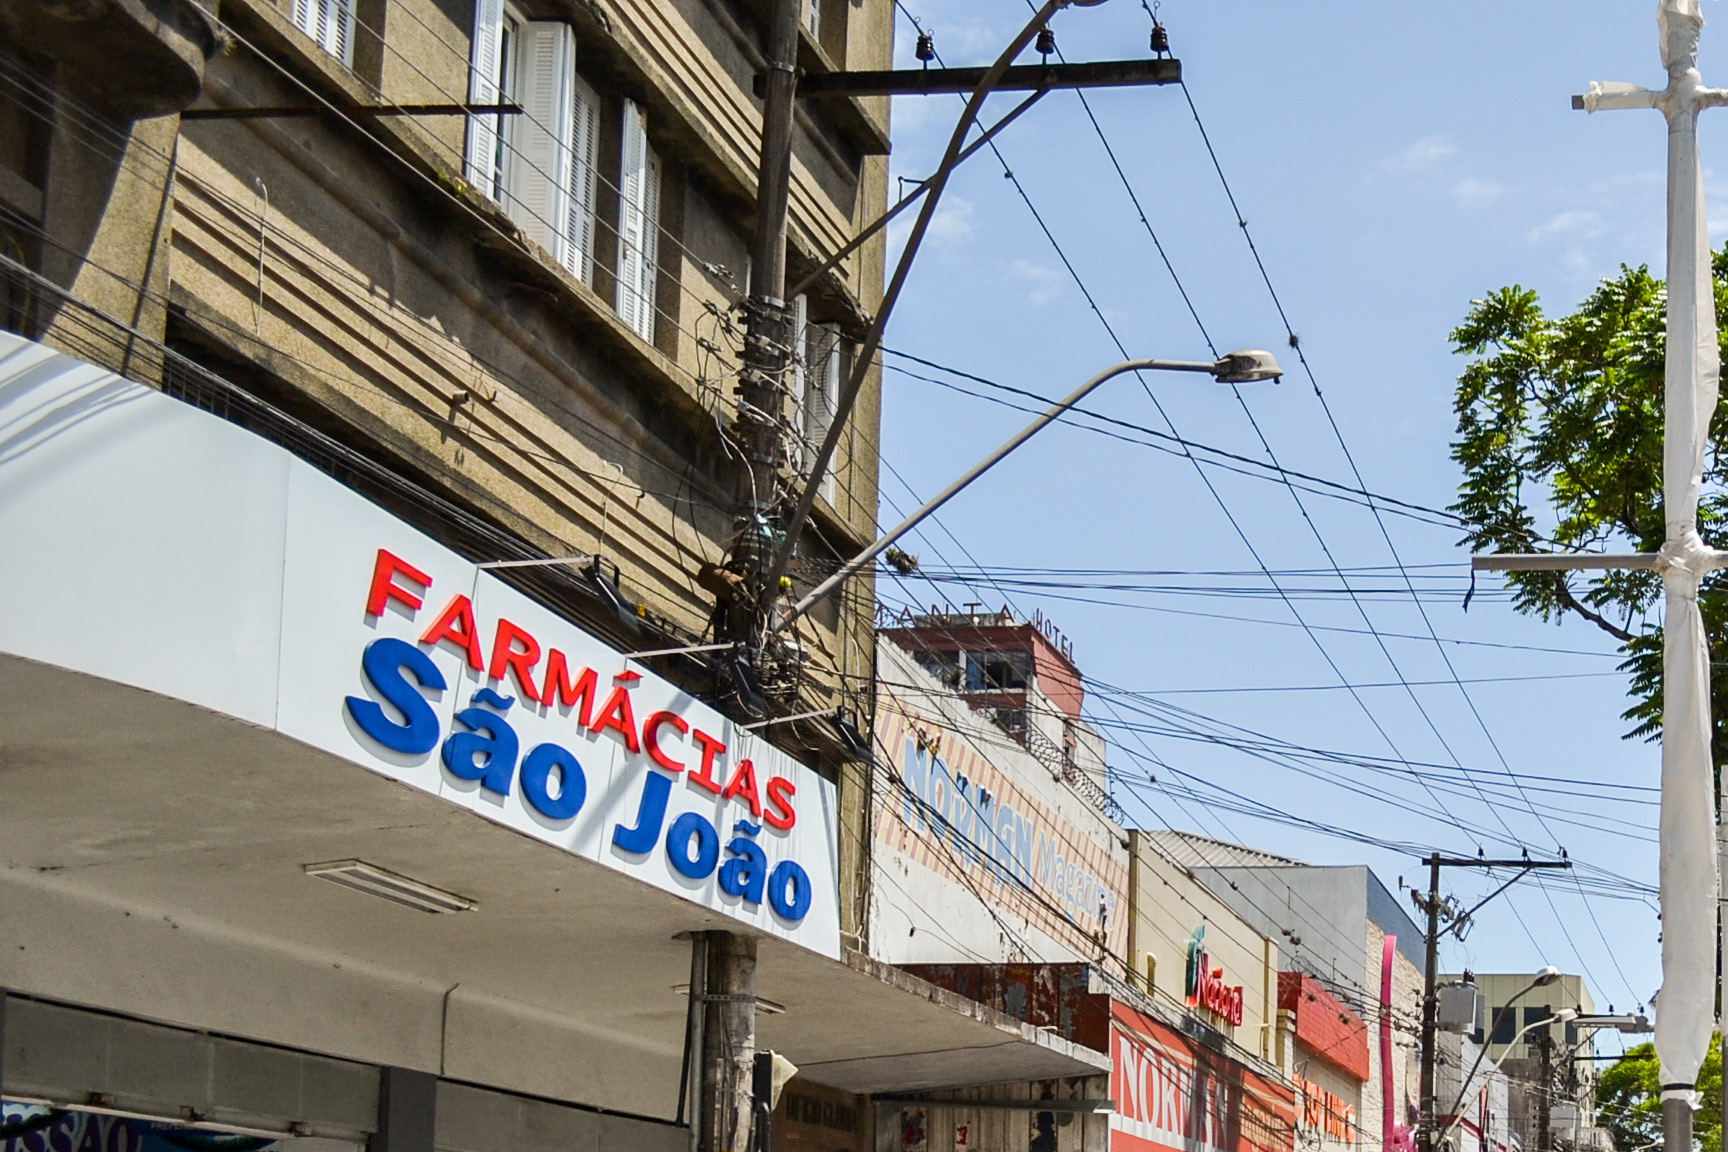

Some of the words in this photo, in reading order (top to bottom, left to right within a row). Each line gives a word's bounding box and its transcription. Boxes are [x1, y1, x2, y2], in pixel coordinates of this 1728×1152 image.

[366, 548, 796, 831] FARMÁCIAS
[1034, 607, 1075, 665] HOTEL
[344, 637, 588, 820] São
[611, 771, 813, 921] João
[1119, 1036, 1229, 1150] NORMAN
